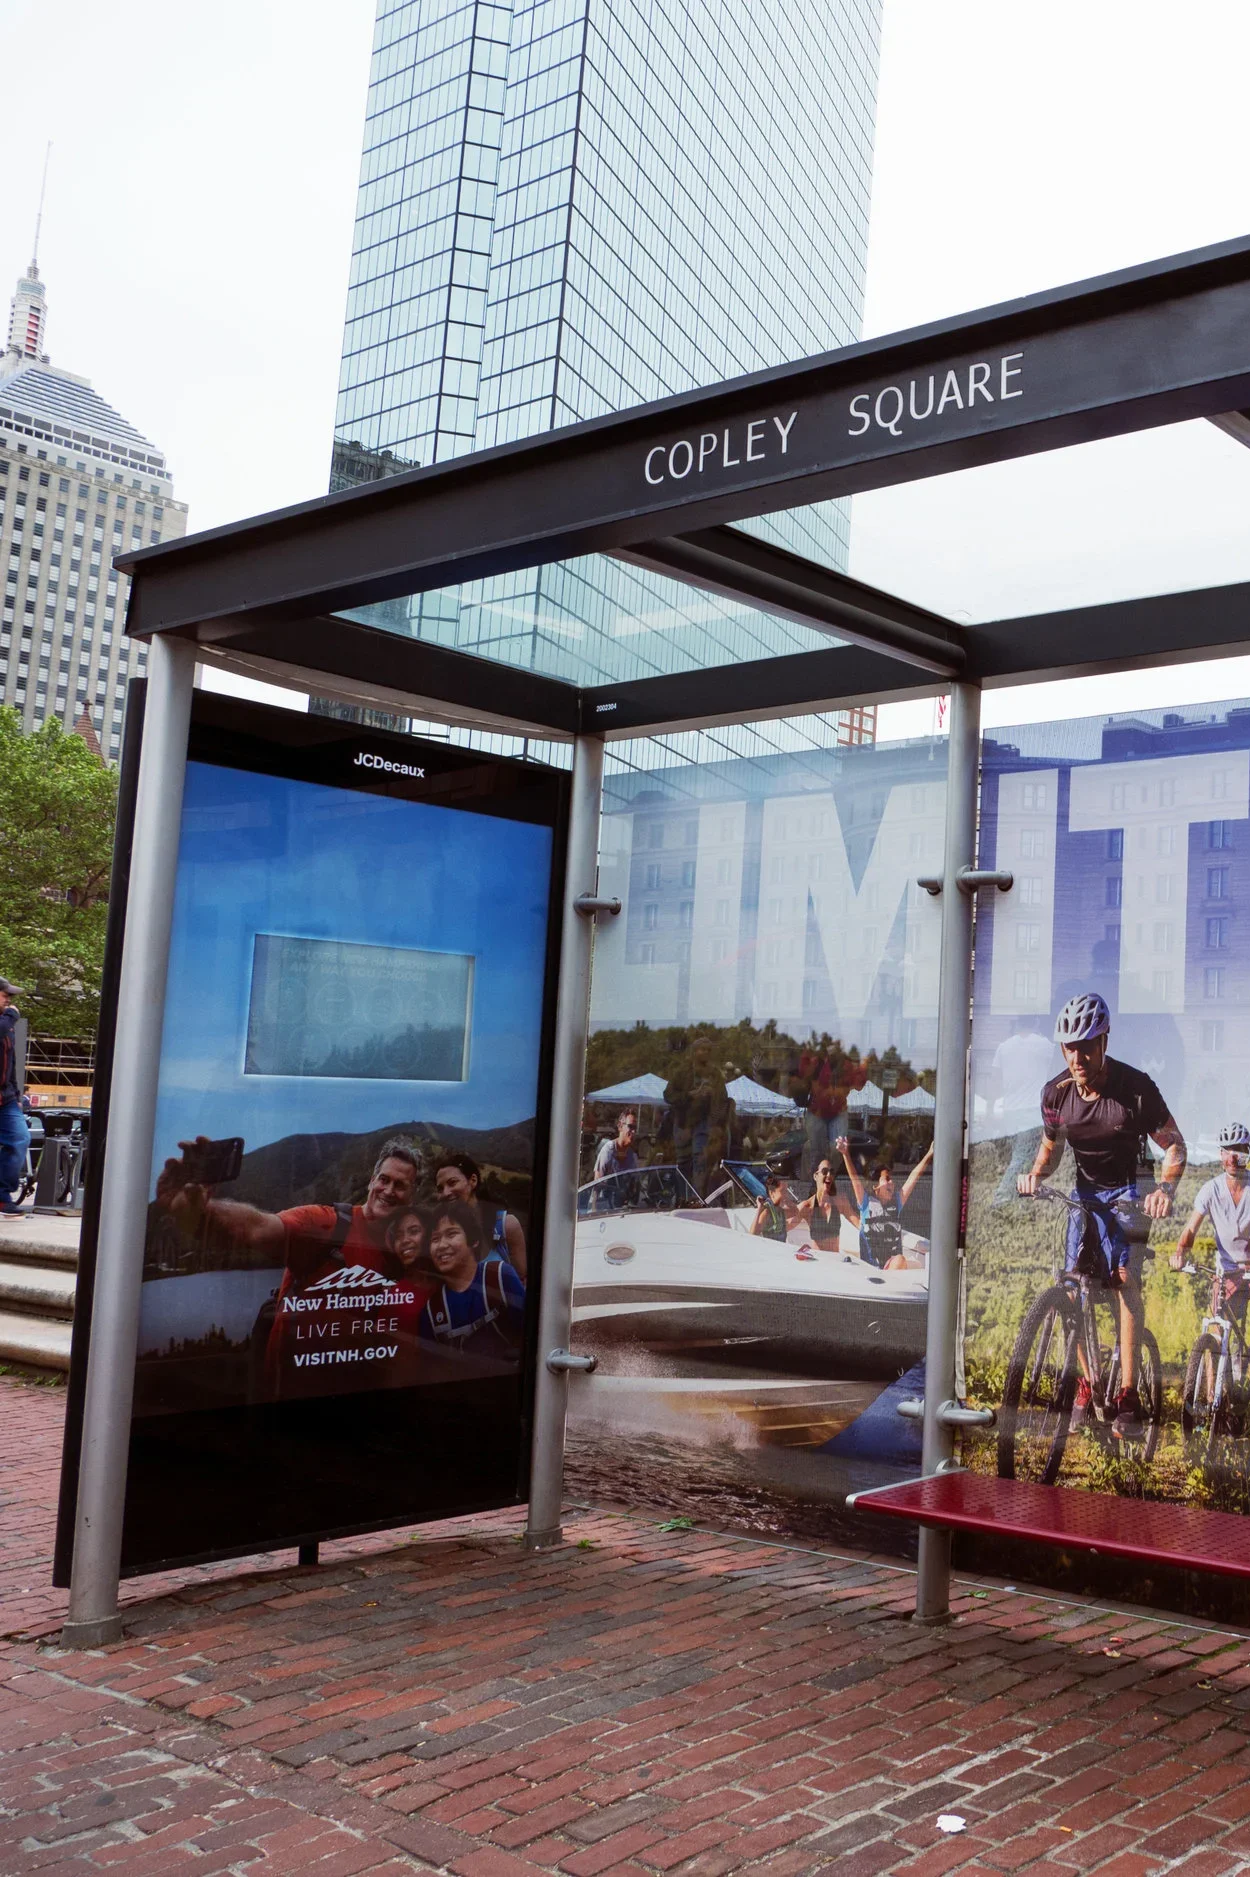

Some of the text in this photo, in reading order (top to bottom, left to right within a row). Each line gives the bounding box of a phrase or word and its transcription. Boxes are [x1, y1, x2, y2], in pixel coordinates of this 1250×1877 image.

[644, 352, 1024, 485] COPLEY SQUARE
[353, 752, 425, 778] JCDecaux
[282, 1288, 415, 1313] New Hampshire
[296, 1317, 399, 1340] LIVE FREE
[293, 1344, 399, 1368] VISITNH.GOV
